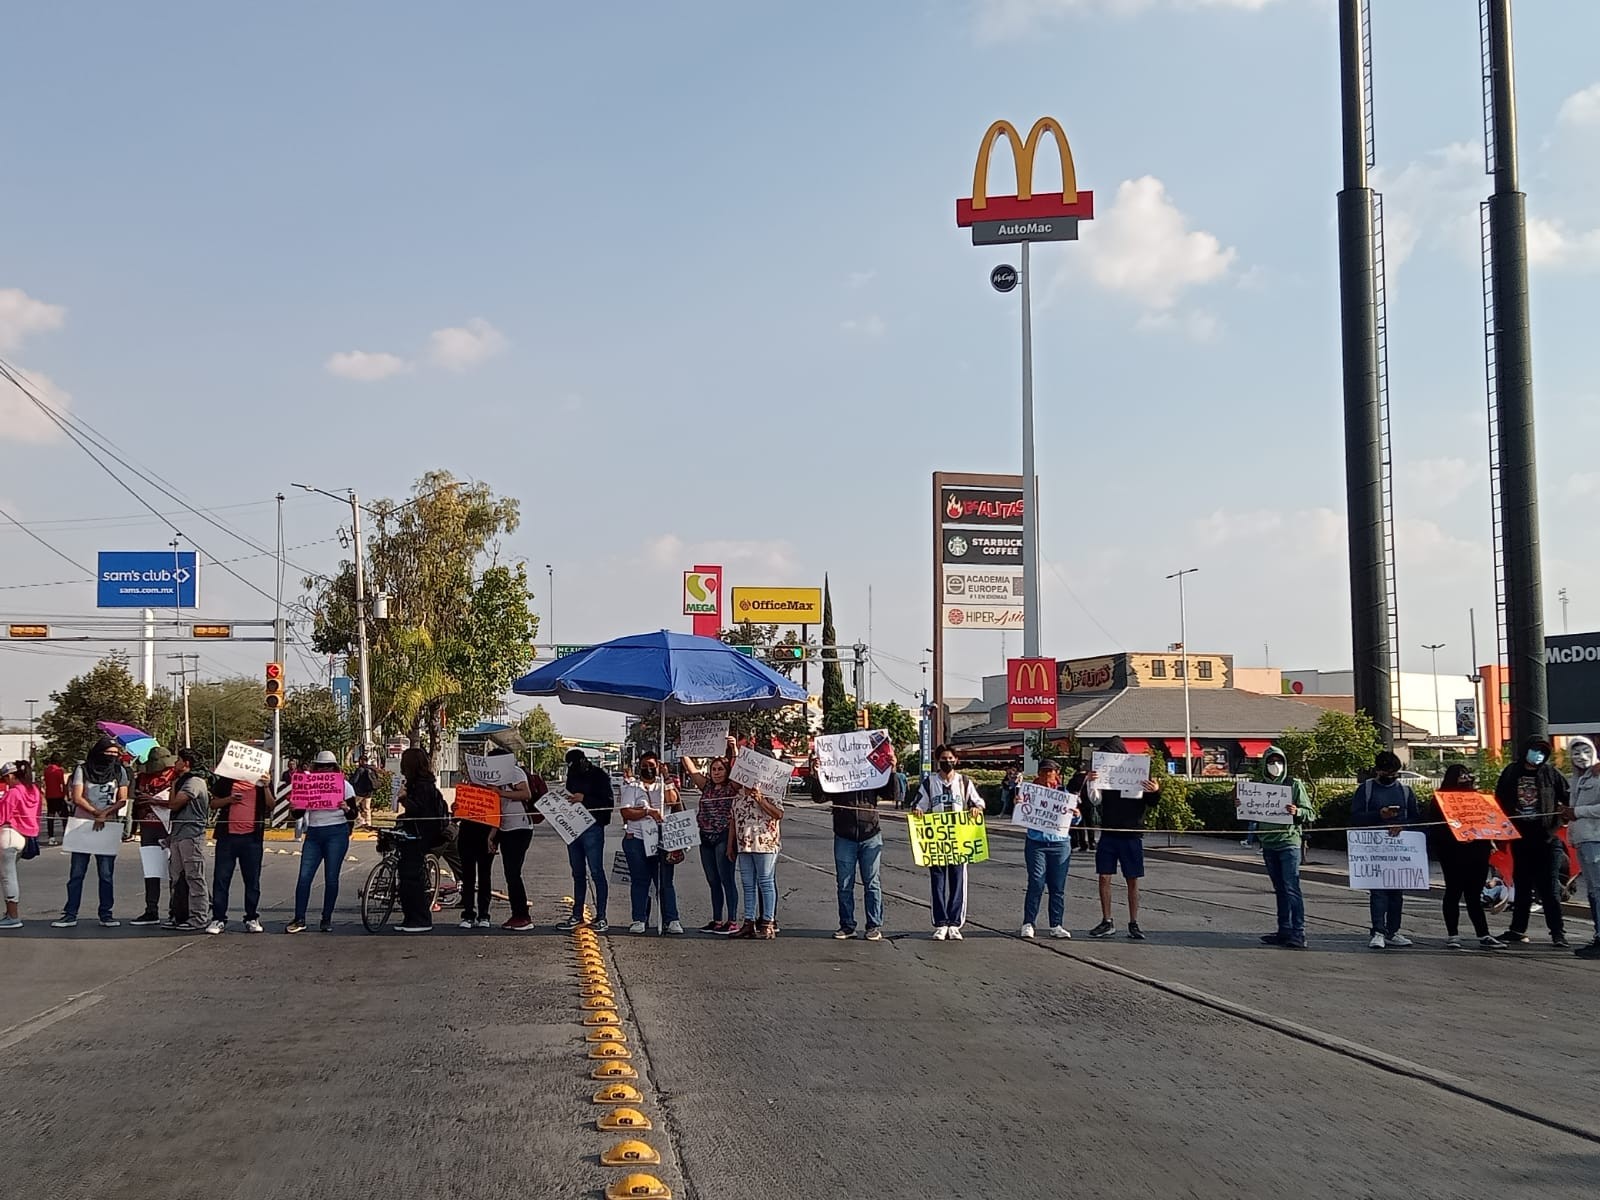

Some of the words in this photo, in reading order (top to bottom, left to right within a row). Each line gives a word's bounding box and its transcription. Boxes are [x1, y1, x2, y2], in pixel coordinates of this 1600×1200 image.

[998, 223, 1052, 235] AutoMac
[972, 538, 1023, 548] STARBUCK
[982, 548, 1019, 556] COFFEE
[102, 569, 141, 582] sam's
[142, 569, 171, 582] club
[966, 575, 1011, 584] ACADEMIA
[968, 585, 1009, 593] EUROPEA
[686, 603, 716, 612] MEGA
[752, 600, 814, 611] OfficeMax
[966, 610, 995, 623] HIPER
[1545, 646, 1600, 663] McDo
[1010, 695, 1056, 705] AutoMac
[293, 774, 304, 782] NO
[306, 774, 336, 783] SOMOS
[734, 772, 750, 784] NO
[1040, 800, 1049, 809] NO
[932, 812, 984, 826] FUTURO
[916, 826, 935, 840] NO
[936, 825, 957, 841] SE
[919, 840, 959, 855] VENDE
[963, 840, 984, 856] SE
[922, 852, 975, 867] DEFIENDE
[1353, 863, 1382, 878] LUCHA
